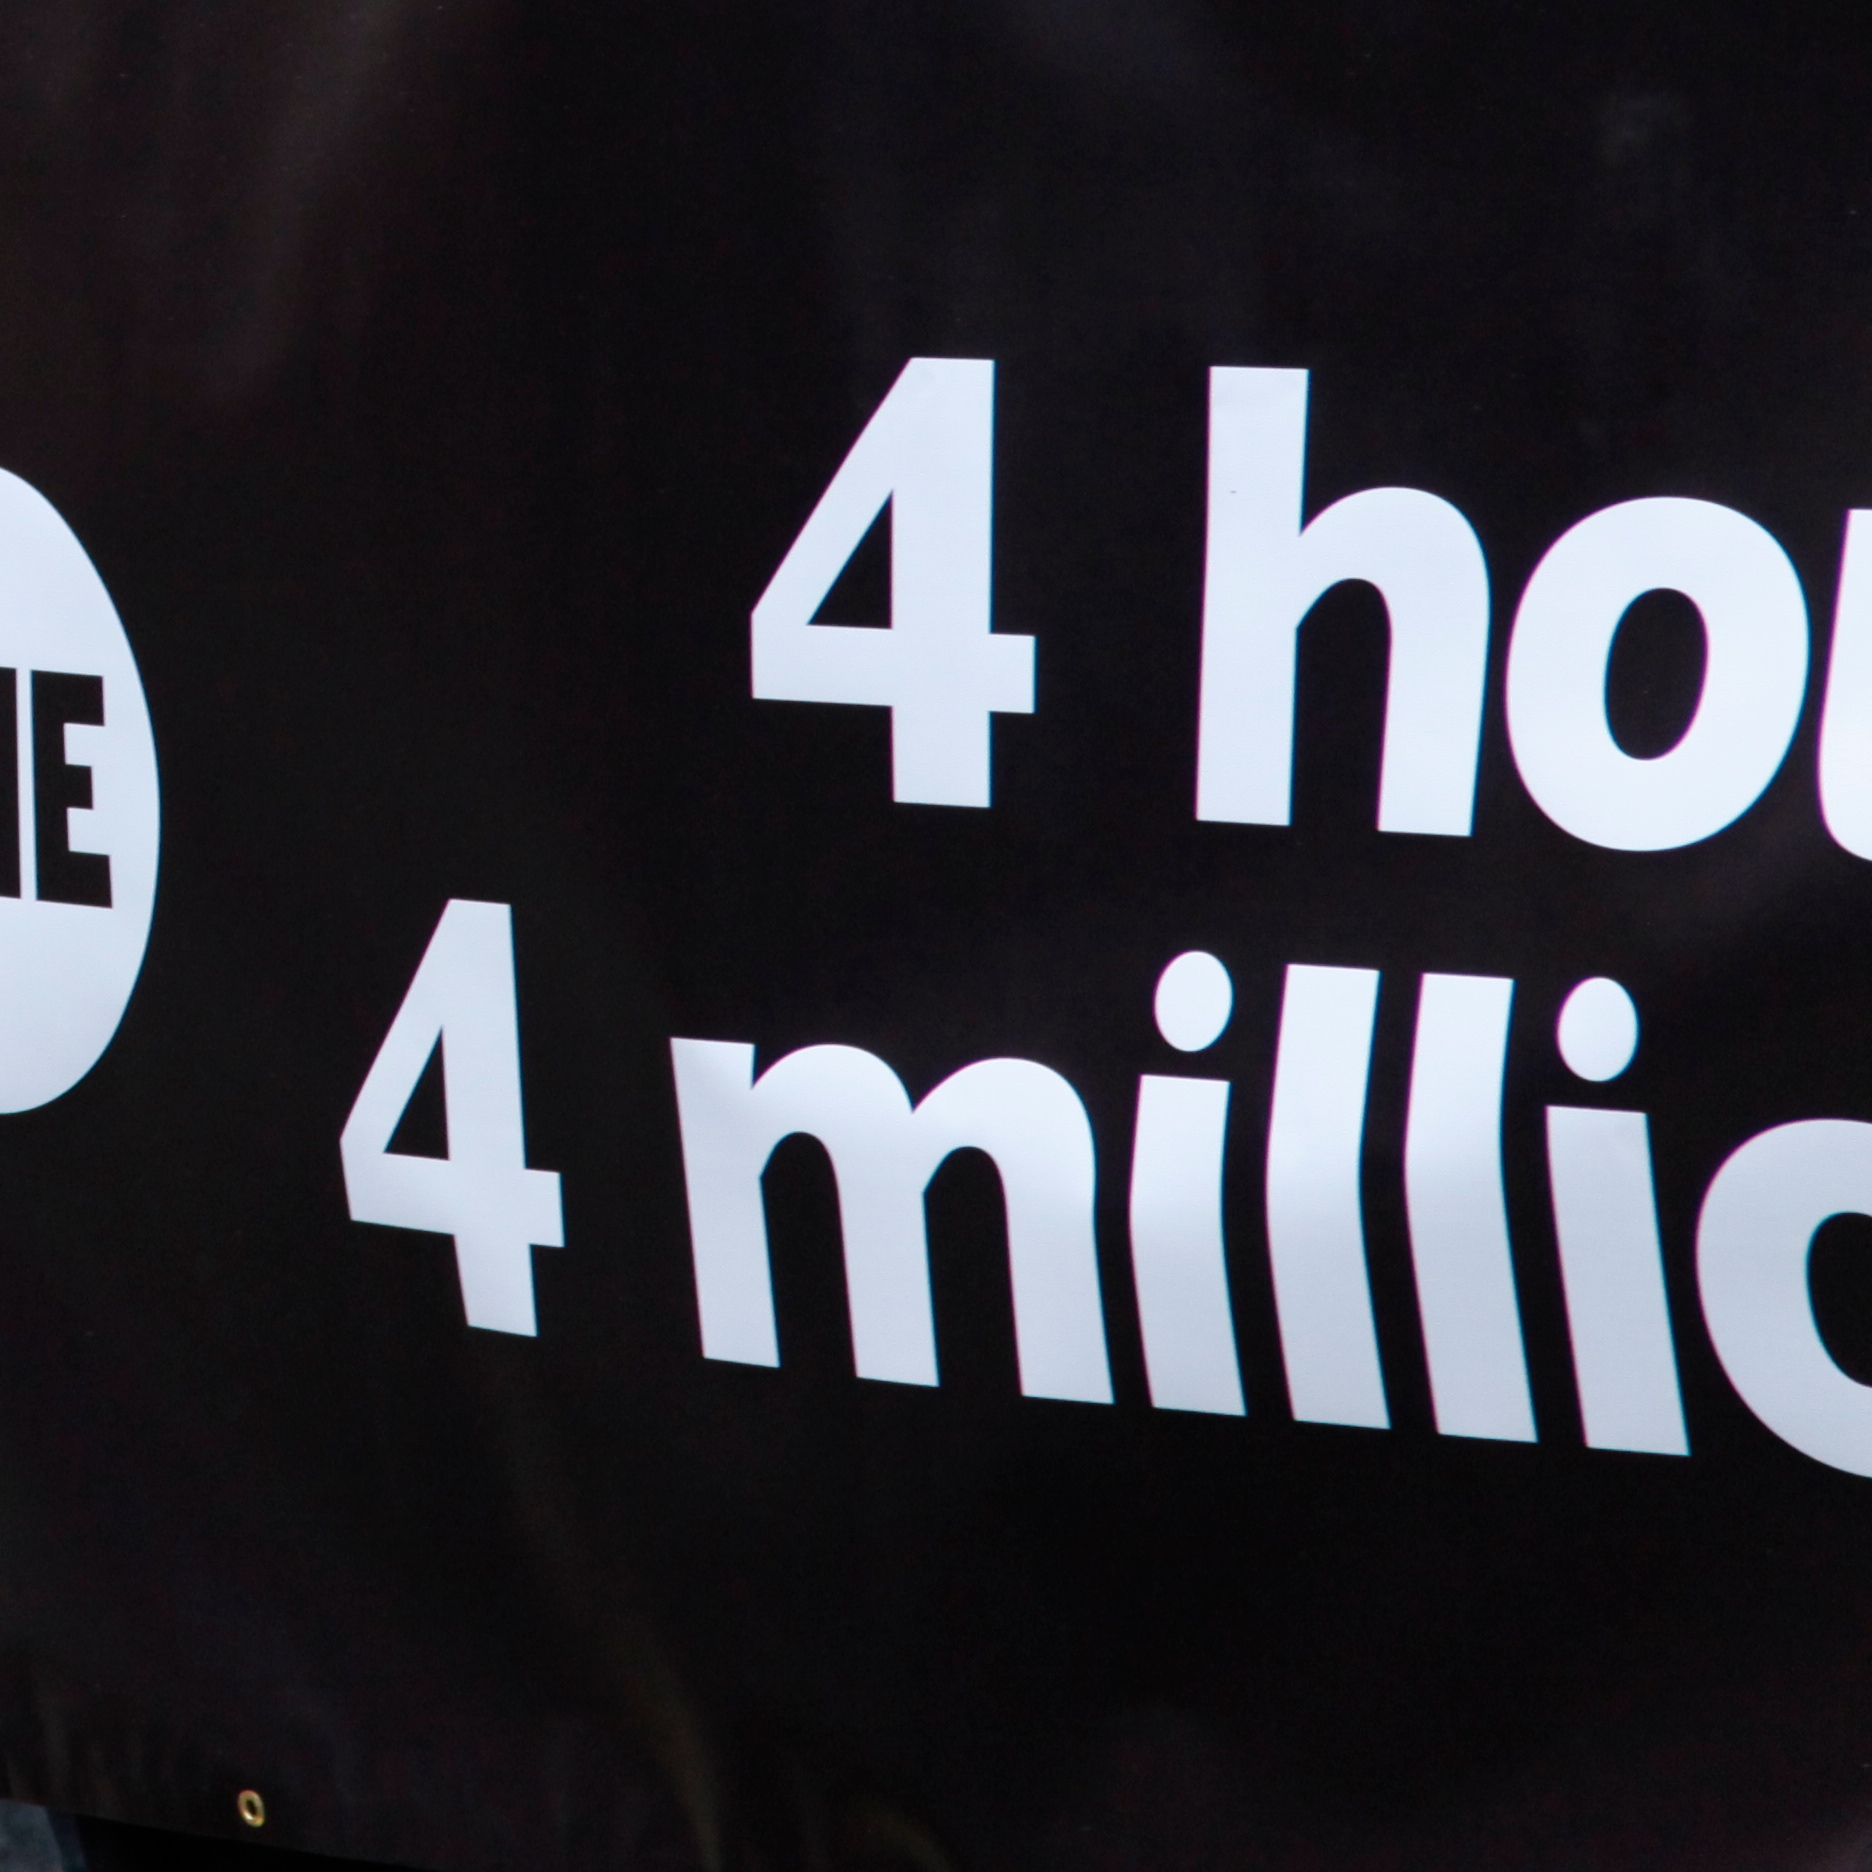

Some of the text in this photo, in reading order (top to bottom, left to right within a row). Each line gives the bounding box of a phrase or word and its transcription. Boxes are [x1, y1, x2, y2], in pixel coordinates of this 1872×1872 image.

[752, 358, 1872, 861] 4 ho
[341, 899, 563, 1336] 4
